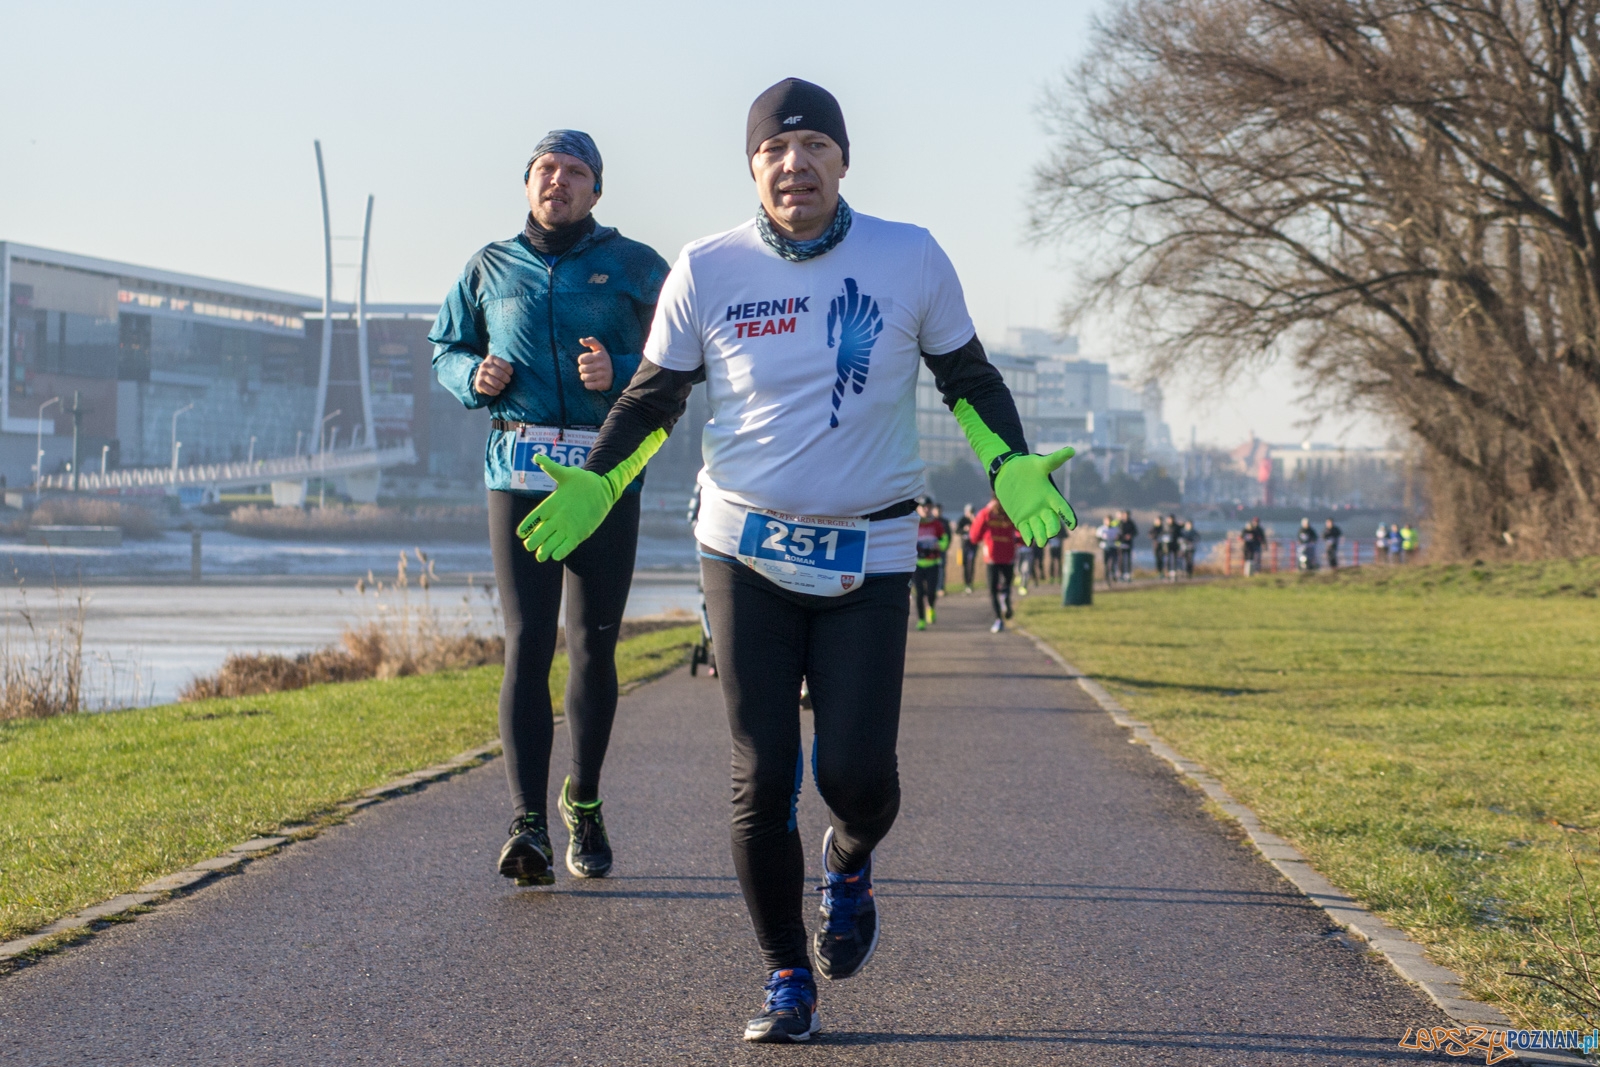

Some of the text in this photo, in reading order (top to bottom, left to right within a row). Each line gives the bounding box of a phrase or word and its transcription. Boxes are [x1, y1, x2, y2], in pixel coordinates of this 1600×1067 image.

[783, 115, 803, 125] 4F
[726, 296, 811, 322] HERNIK
[734, 317, 797, 339] TEAM
[817, 518, 856, 528] BURGIELA
[761, 520, 839, 561] 251
[784, 554, 816, 566] ROMAN
